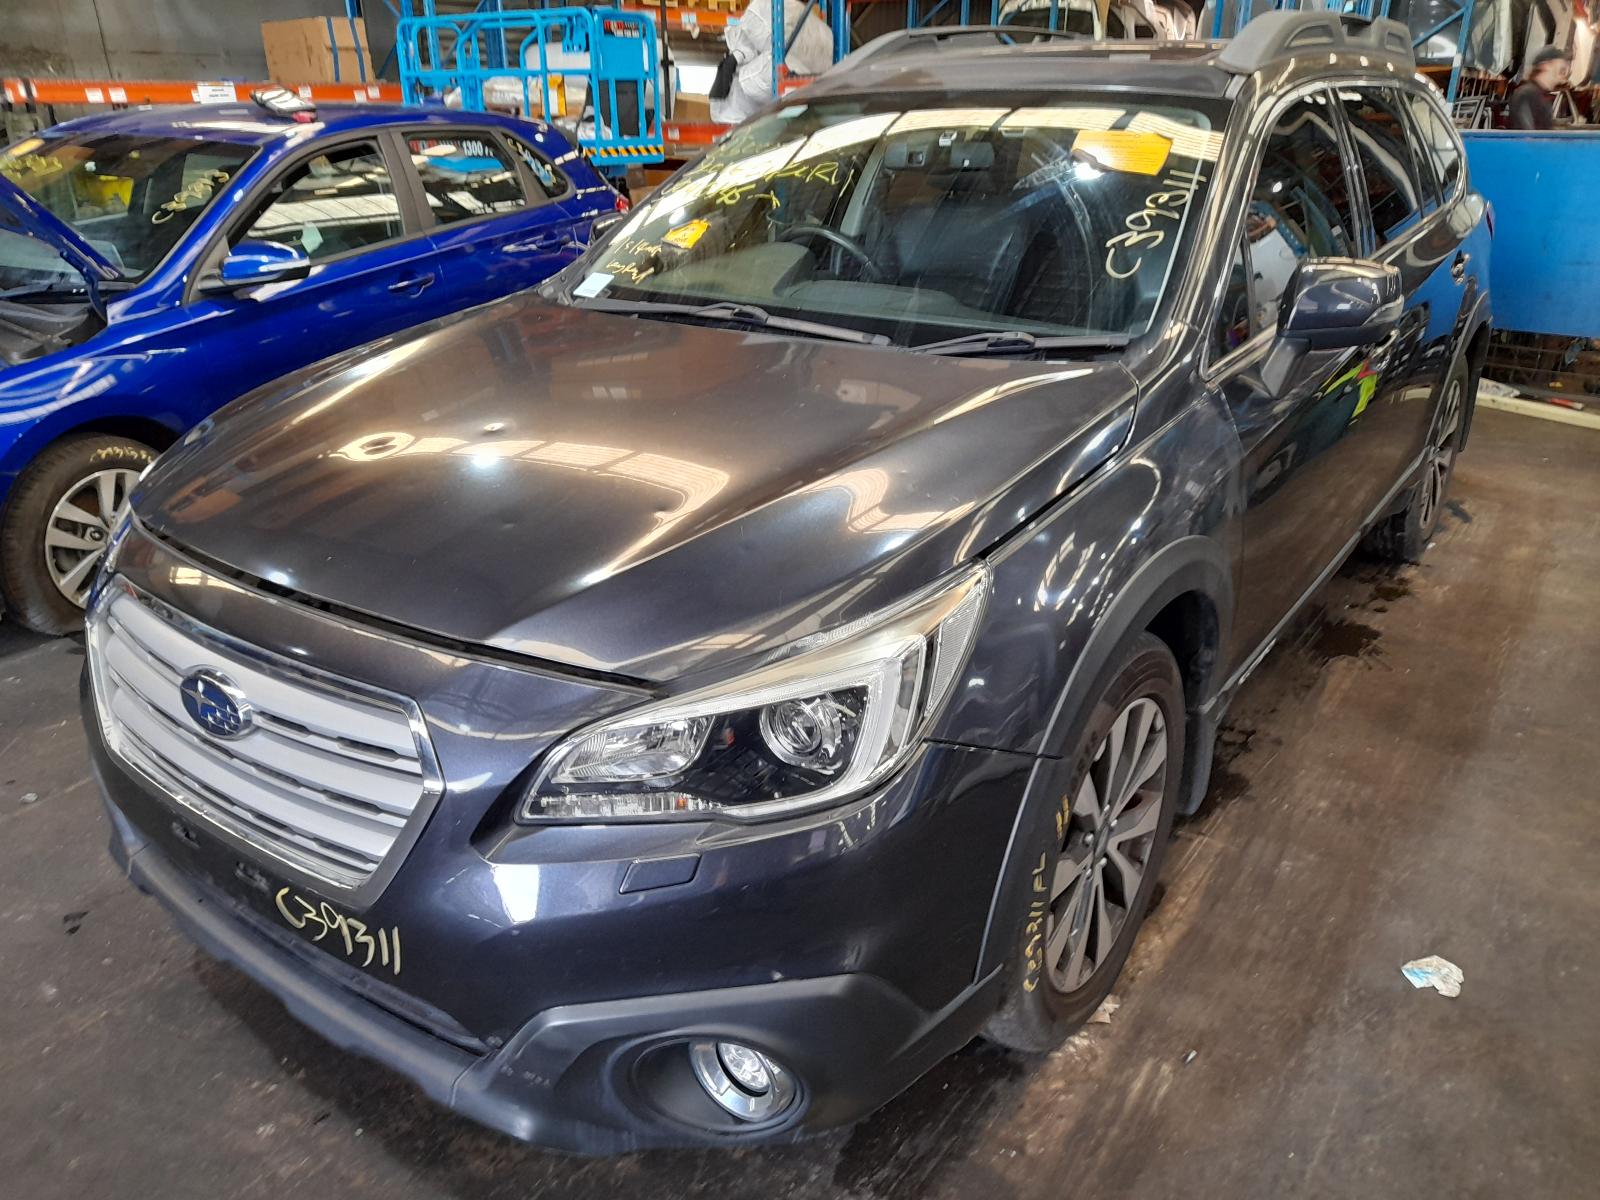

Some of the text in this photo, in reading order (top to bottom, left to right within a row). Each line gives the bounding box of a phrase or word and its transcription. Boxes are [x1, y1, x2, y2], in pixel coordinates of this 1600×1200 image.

[462, 139, 484, 156] 1300
[1105, 169, 1207, 279] C39311
[275, 886, 401, 976] C39311
